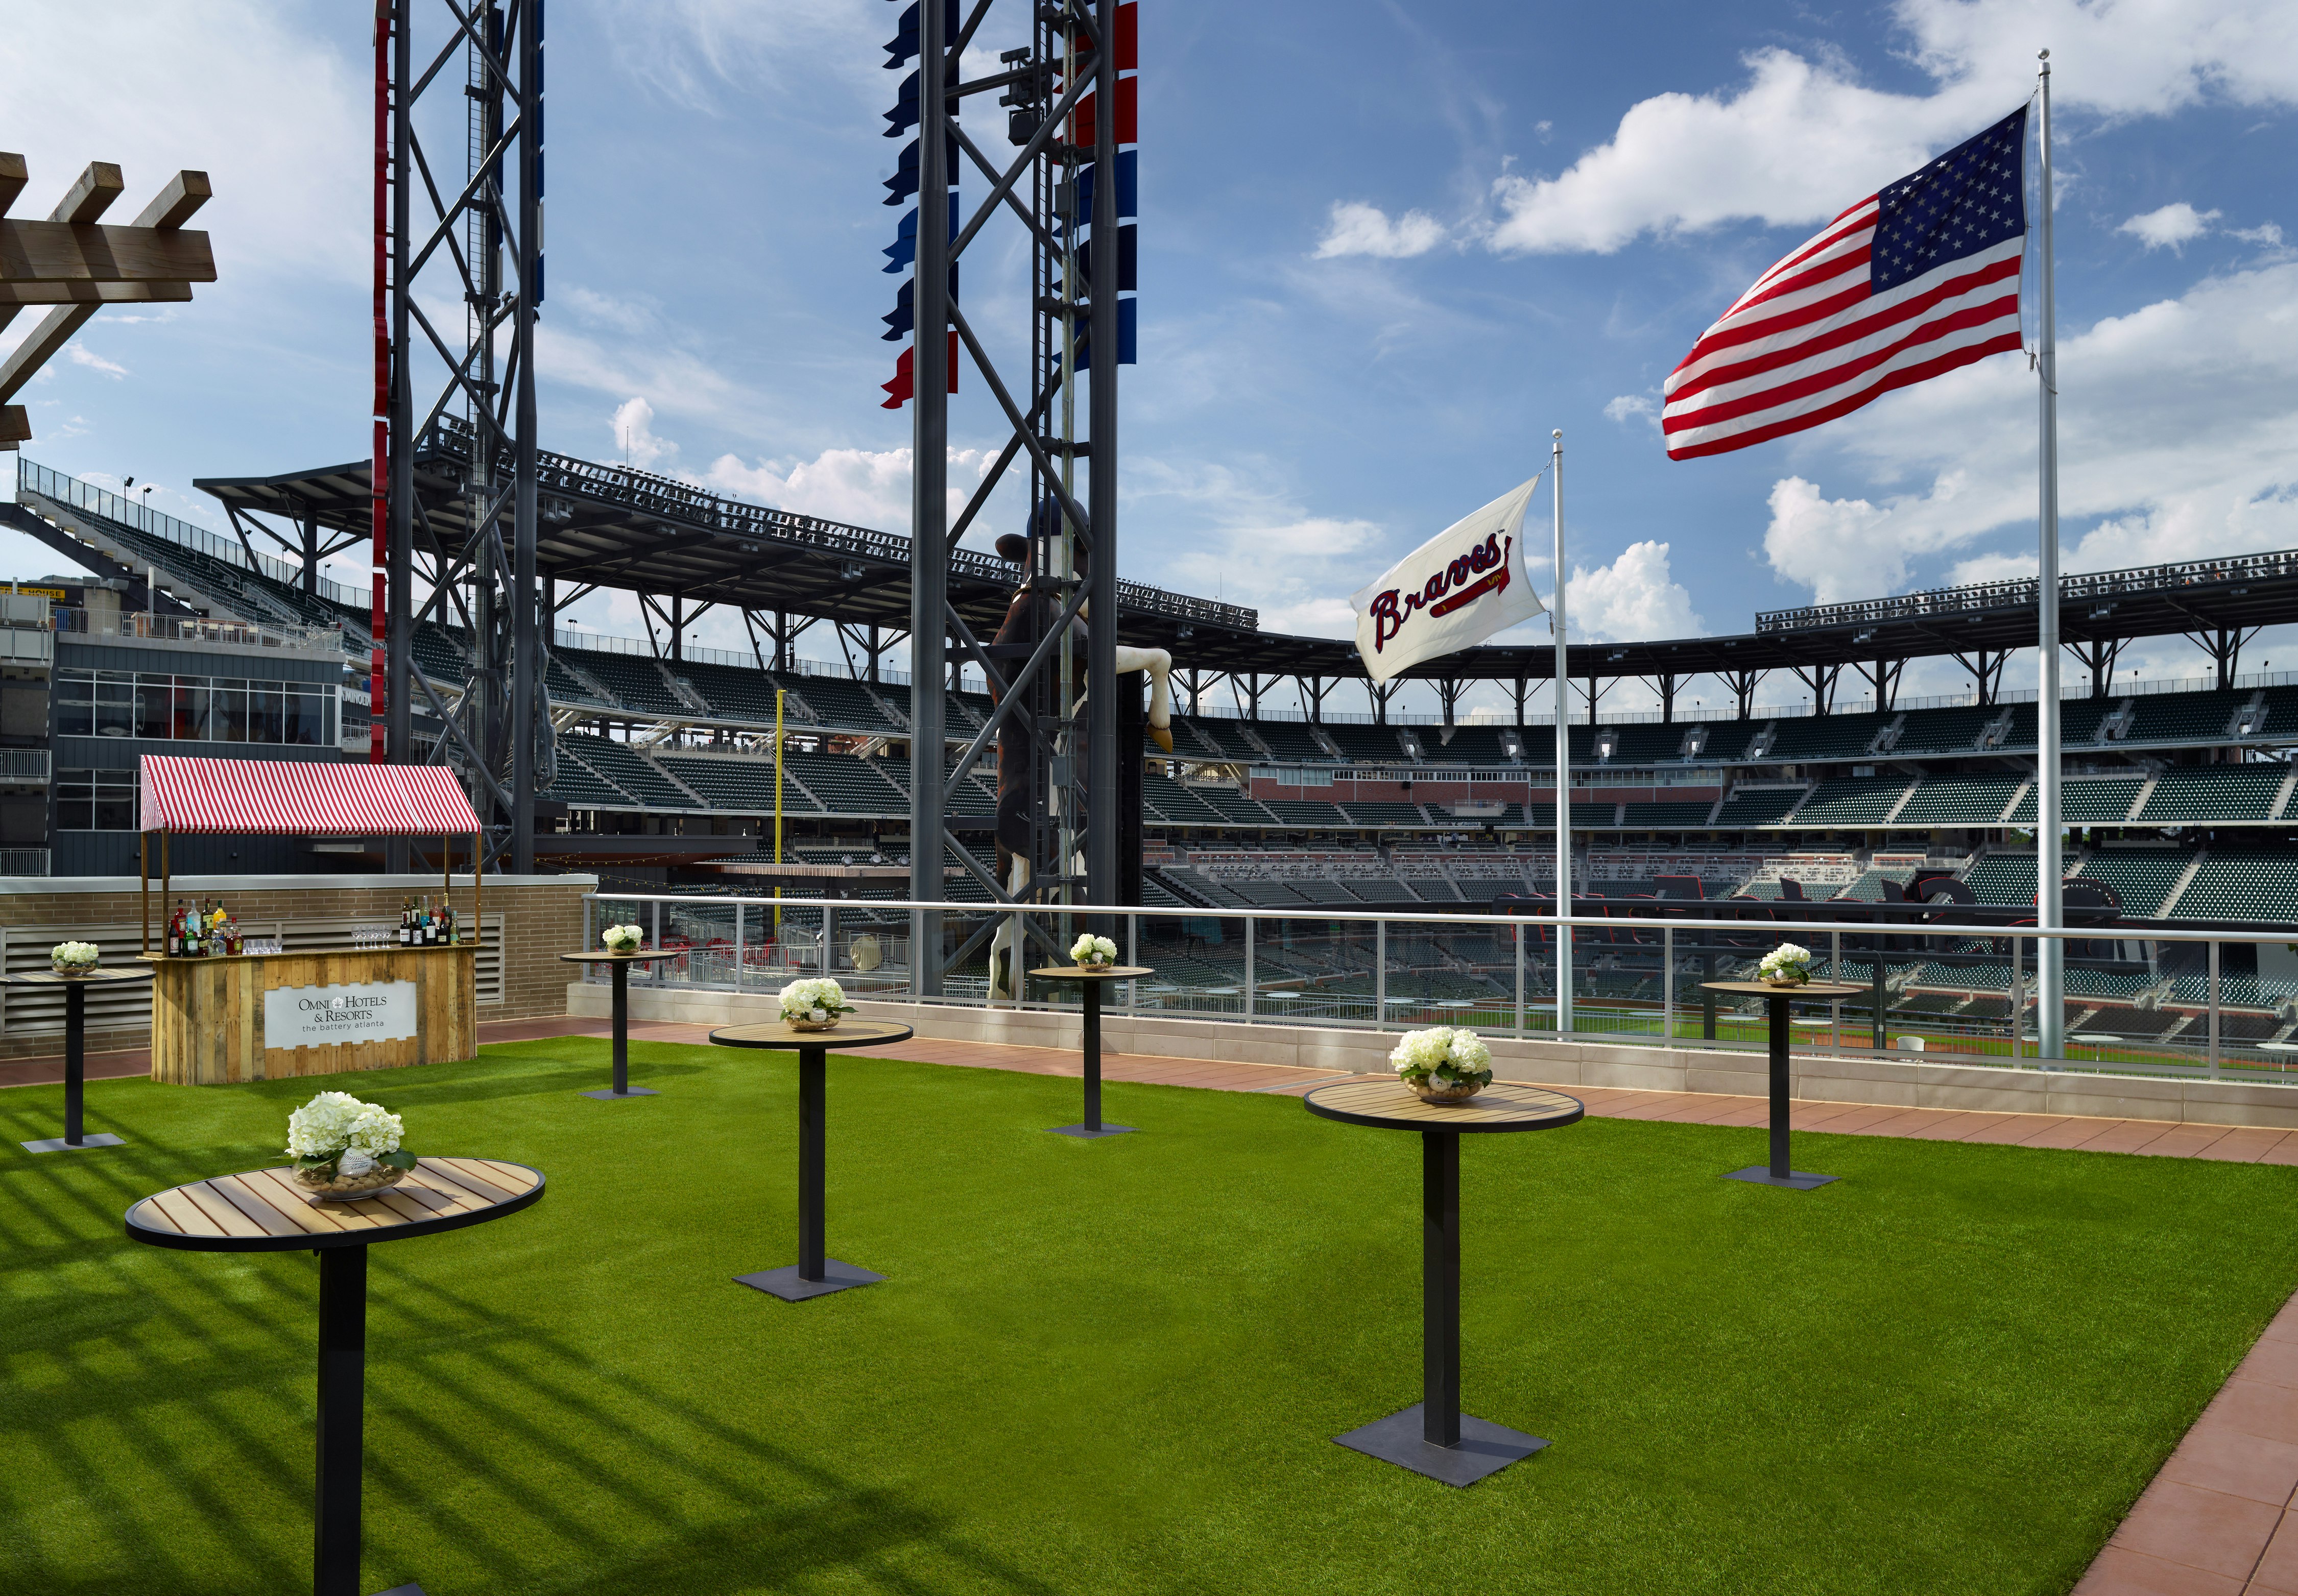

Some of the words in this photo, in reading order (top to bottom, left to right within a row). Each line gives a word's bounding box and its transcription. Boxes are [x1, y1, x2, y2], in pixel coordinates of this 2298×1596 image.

[1370, 533, 1501, 654] Braves
[345, 691, 371, 707] MINOLTA
[299, 999, 329, 1011] OMNI
[345, 996, 387, 1008] HOTELS
[314, 1013, 324, 1023] &
[325, 1010, 372, 1022] RESORTS
